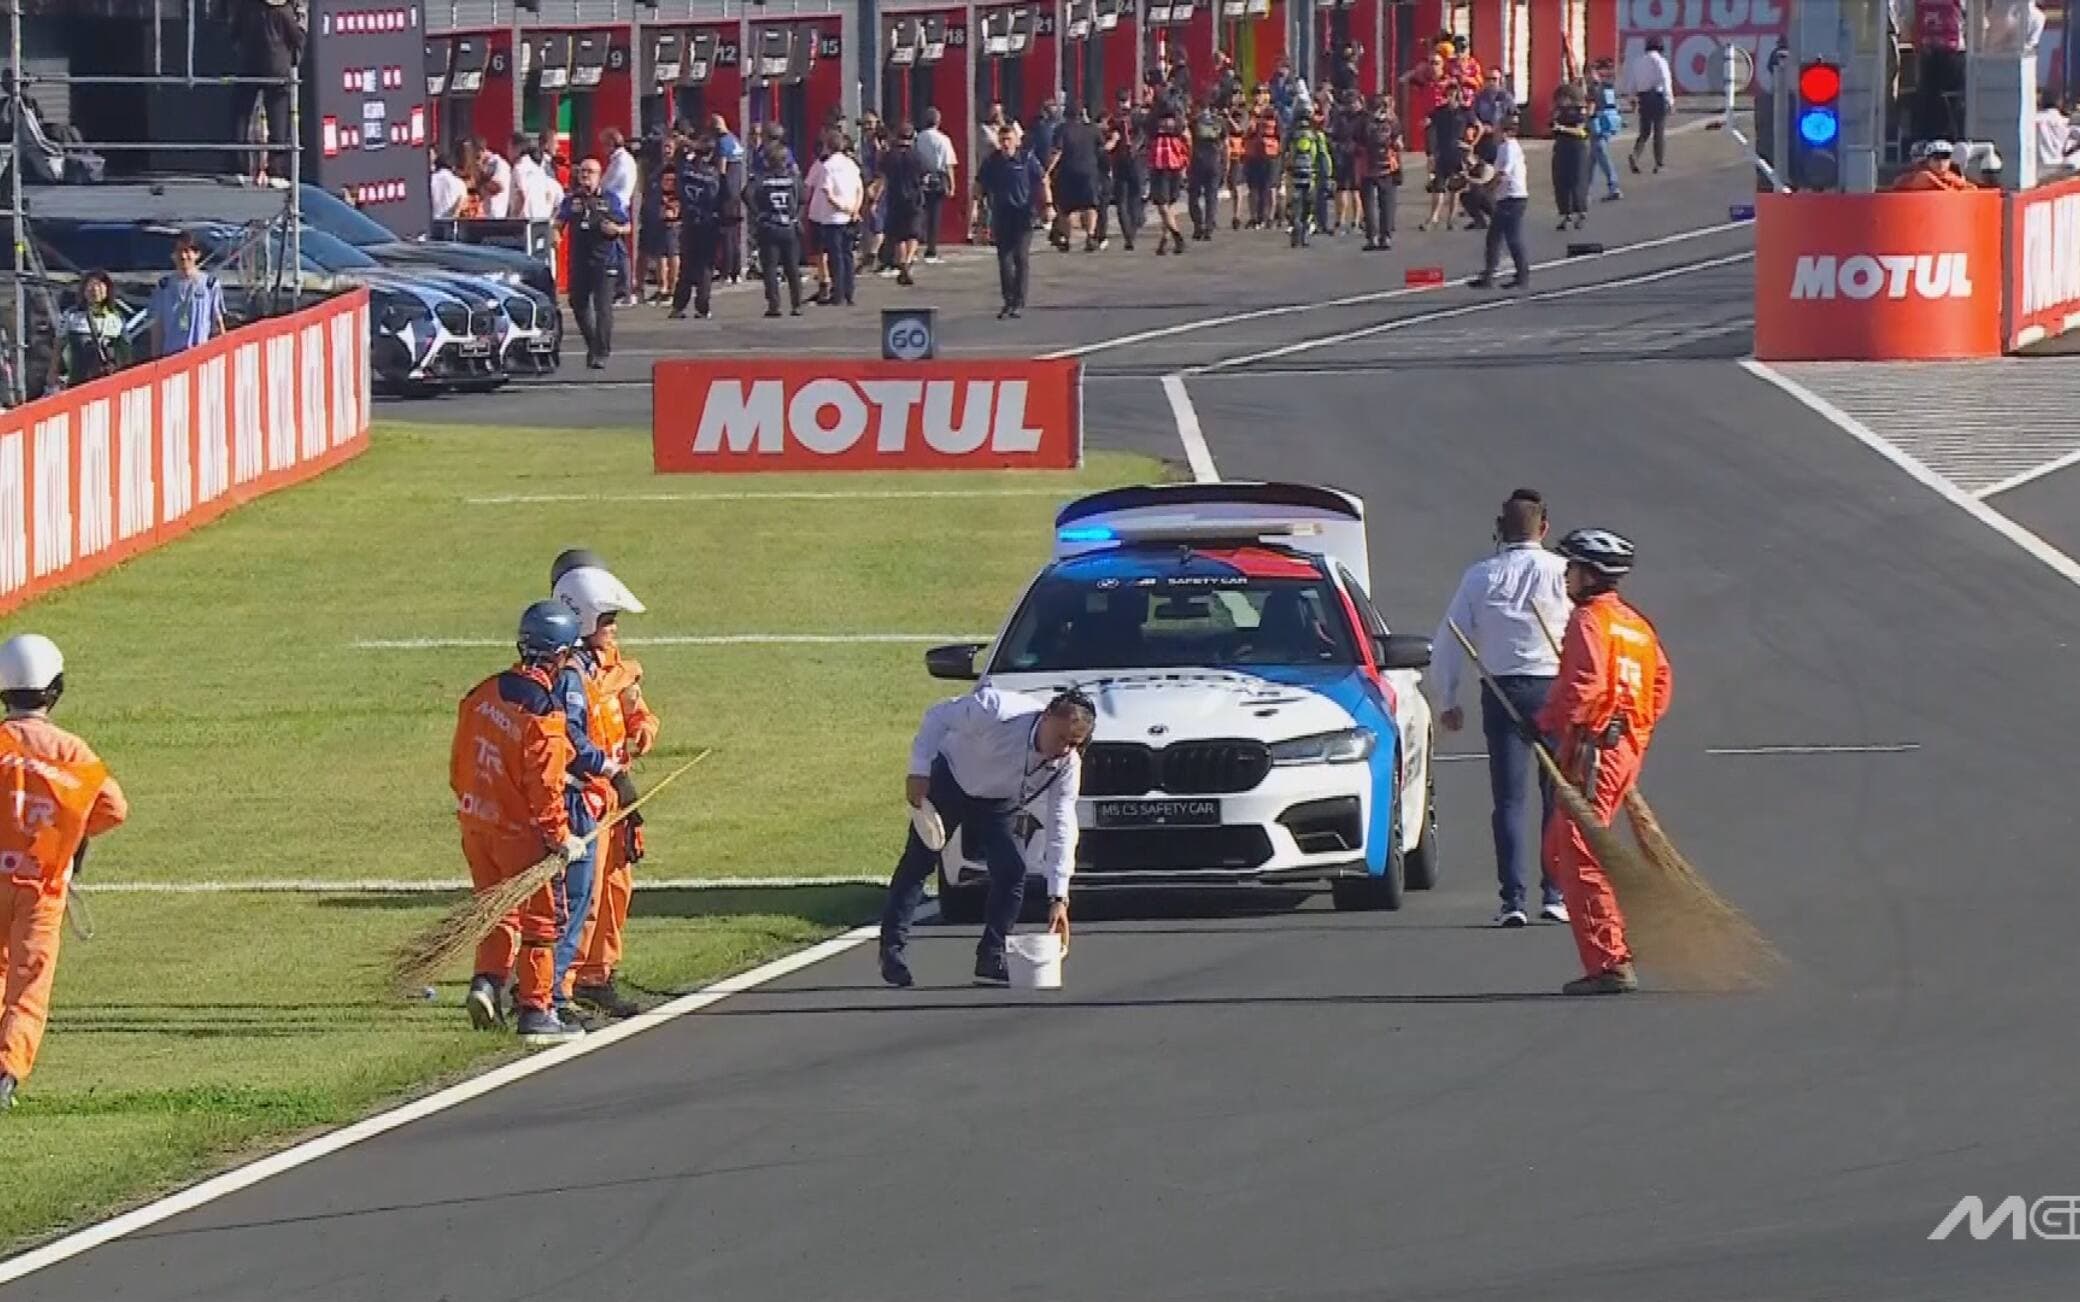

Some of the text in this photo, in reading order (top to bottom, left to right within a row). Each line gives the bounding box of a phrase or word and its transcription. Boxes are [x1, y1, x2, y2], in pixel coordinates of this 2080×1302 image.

[822, 39, 839, 54] 15
[492, 54, 505, 71] 6
[610, 50, 624, 68] 9
[1790, 252, 1972, 300] MOTUL
[891, 328, 928, 349] 60
[692, 378, 1043, 454] MOTUL
[1168, 577, 1218, 585] SAFETY
[1140, 802, 1188, 815] SAFETY
[1189, 801, 1215, 814] CAR
